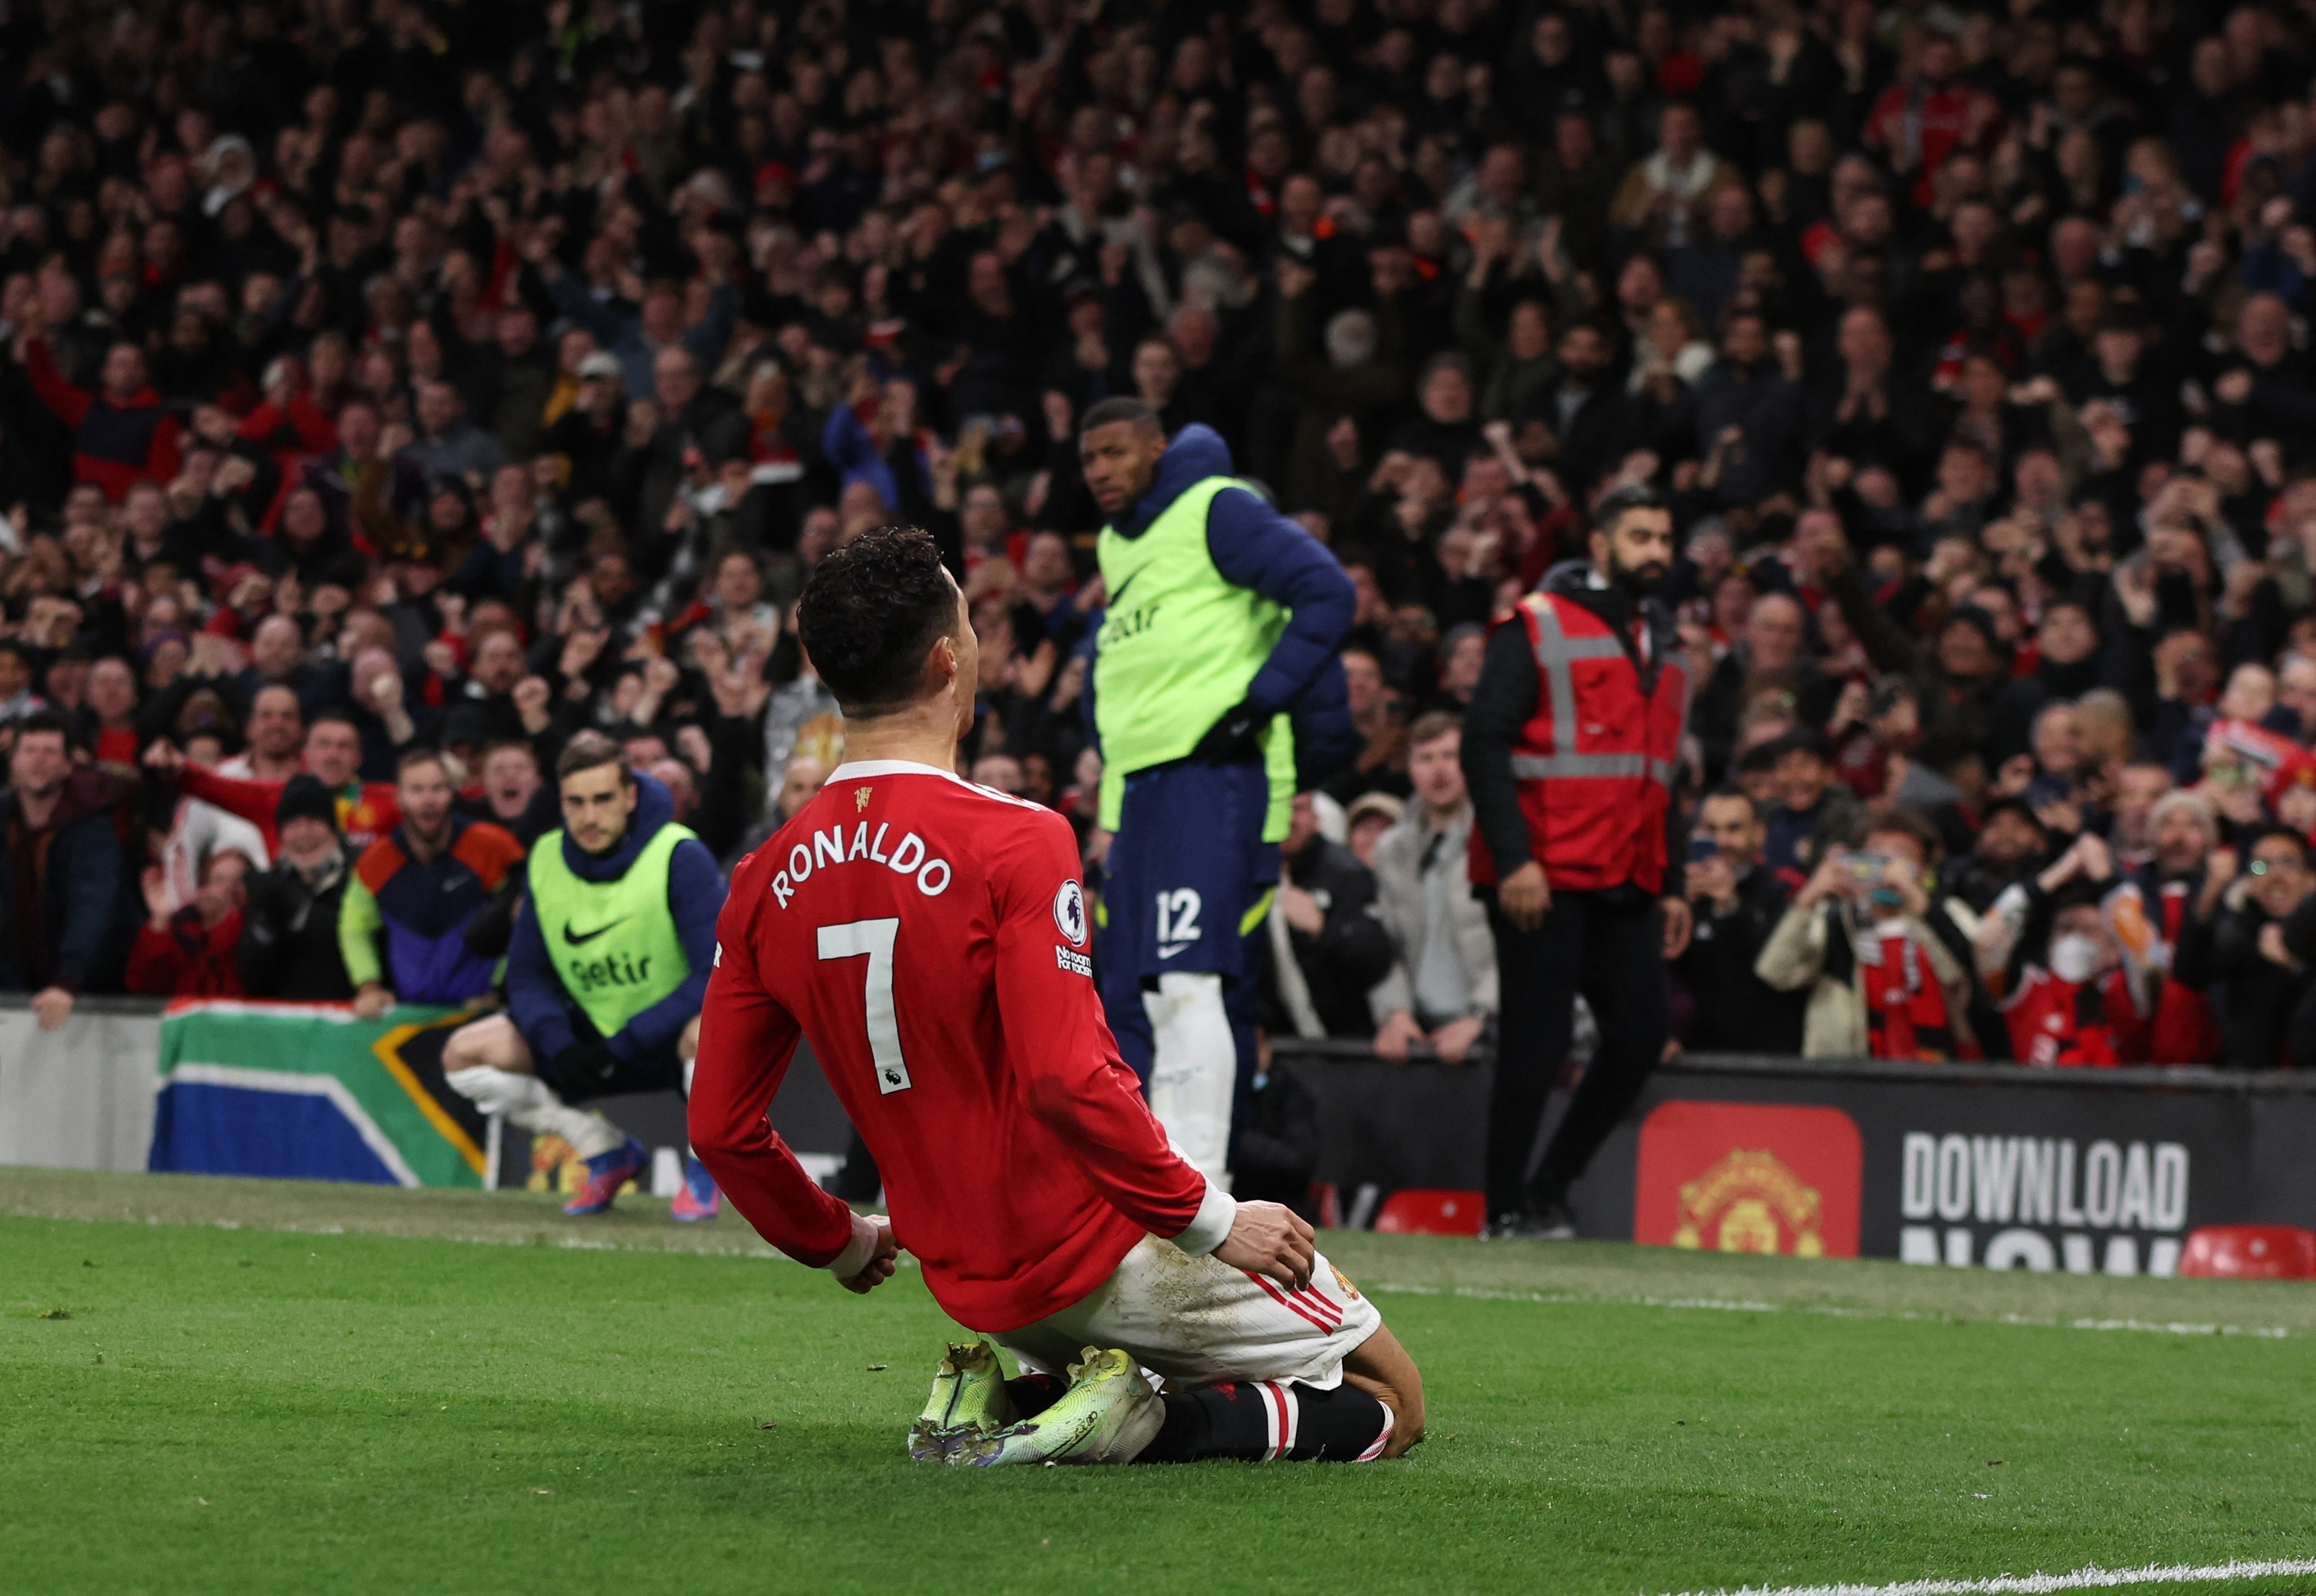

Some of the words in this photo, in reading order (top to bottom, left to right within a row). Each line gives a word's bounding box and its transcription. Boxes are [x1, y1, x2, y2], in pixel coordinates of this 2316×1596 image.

[771, 820, 951, 910] RONALDO
[1055, 945, 1070, 959] No
[1070, 951, 1091, 967] room
[1156, 888, 1202, 942] 12
[817, 917, 912, 1095] 7
[1902, 1132, 2190, 1230] DOWNLOAD
